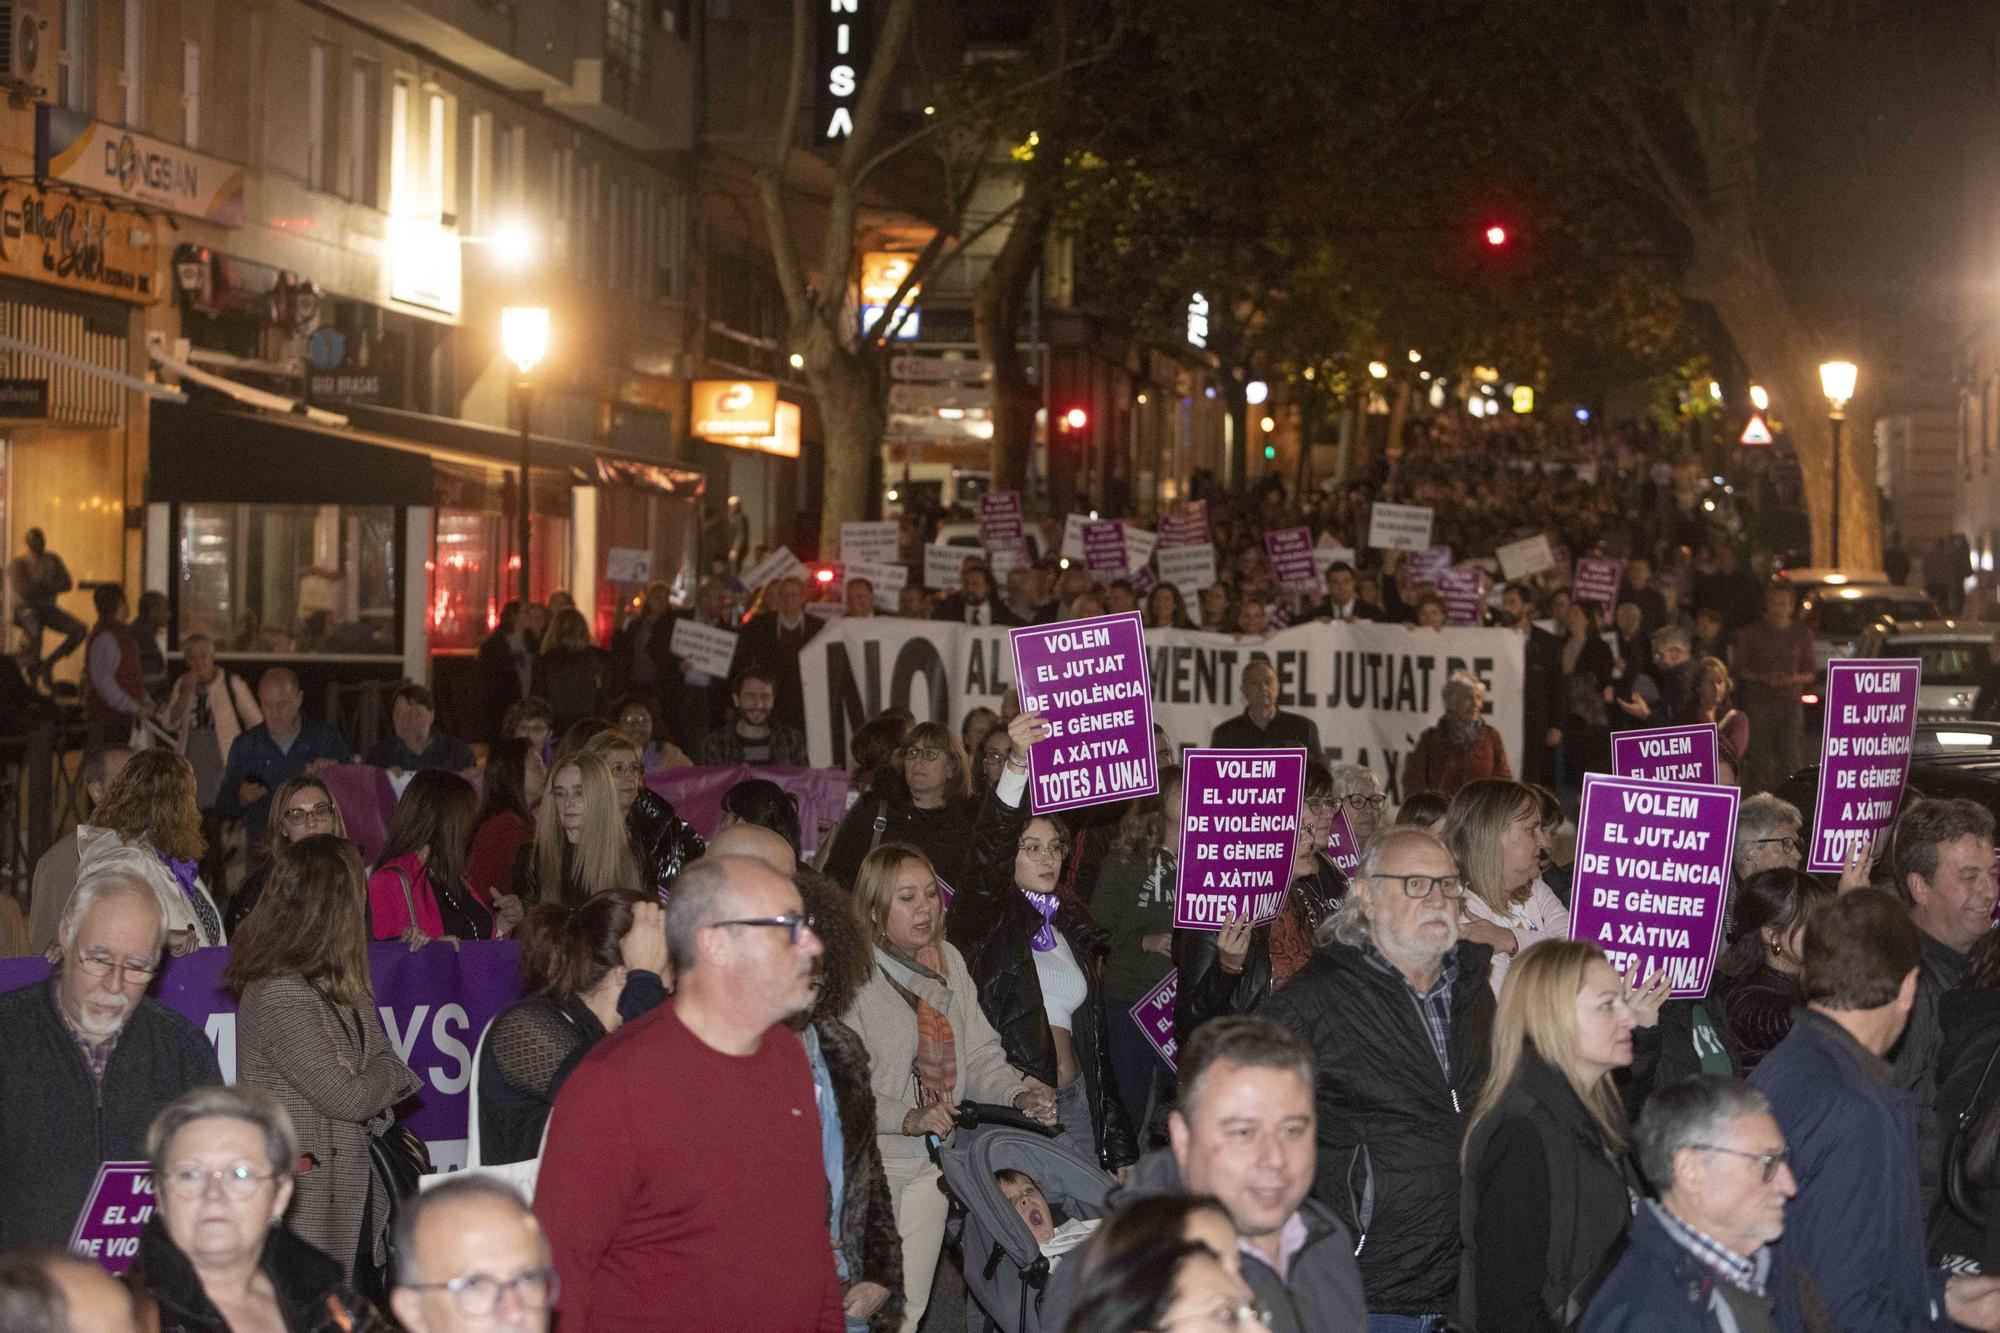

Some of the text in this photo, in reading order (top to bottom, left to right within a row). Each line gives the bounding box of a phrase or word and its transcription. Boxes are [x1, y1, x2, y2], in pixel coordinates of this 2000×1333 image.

[1044, 628, 1110, 653] VOLEM
[1036, 654, 1125, 682] EL JUTJAT
[1854, 672, 1901, 694] VOLEM
[825, 636, 949, 772] NO
[966, 638, 1009, 695] AL
[1146, 646, 1237, 705] MENT
[1327, 651, 1435, 713] JUTJAT
[1026, 680, 1144, 712] DE VIOLÈNCIA
[1041, 710, 1135, 739] DE GÈNERE
[1843, 704, 1907, 724] EL JUTJAT
[1053, 739, 1129, 766] A XÀTIVA
[1639, 737, 1692, 758] VOLEM
[1828, 733, 1911, 756] DE VIOLÈNCIA
[1039, 758, 1149, 803] TOTES A UNA!
[1216, 761, 1276, 779] VOLEM
[1652, 762, 1703, 781] JUTJAT
[1836, 765, 1903, 789] DE GÈNERE
[1203, 788, 1286, 805] EL JUTJAT
[1622, 791, 1699, 819] VOLEM
[1841, 798, 1893, 821] A XÀTIVA
[1187, 812, 1295, 832] DE VIOLÈNCIA
[1603, 822, 1710, 851] EL JUTJAT
[1197, 841, 1284, 860] DE GÈNERE
[1203, 868, 1274, 888] A XÀTIVA
[1582, 853, 1721, 885] DE VIOLÈNCIA
[1186, 893, 1237, 923] TOTES
[1253, 891, 1282, 921] UNA!
[1592, 888, 1705, 917] DE GÈNERE
[1598, 921, 1690, 949] A XÀTIVA
[1603, 949, 1639, 986] TES
[1661, 956, 1705, 989] UNA!
[1156, 1017, 1173, 1033] EL
[102, 1206, 126, 1225] EL
